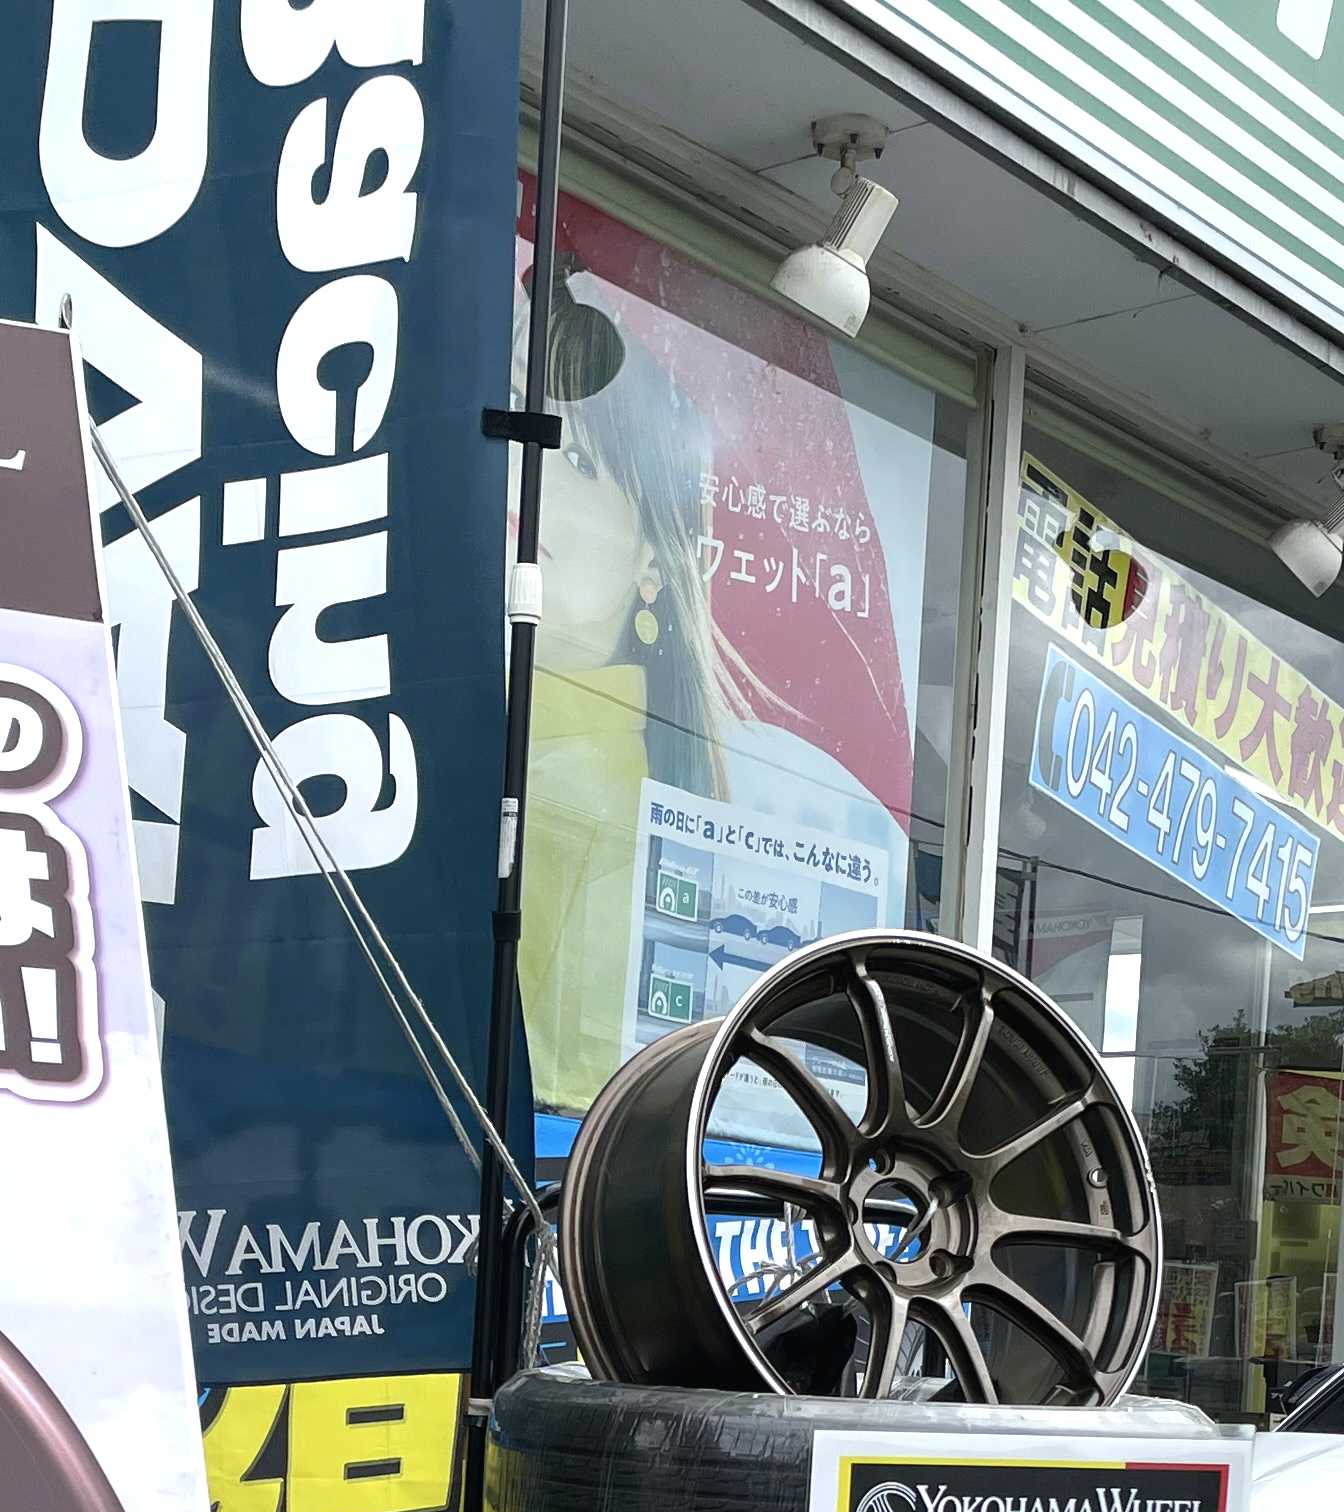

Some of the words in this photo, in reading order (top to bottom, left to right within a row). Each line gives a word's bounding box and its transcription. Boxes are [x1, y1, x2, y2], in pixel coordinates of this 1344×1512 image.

[698, 472, 871, 544] 安心感で選ぶなら
[1064, 687, 1314, 943] 042-479-7415
